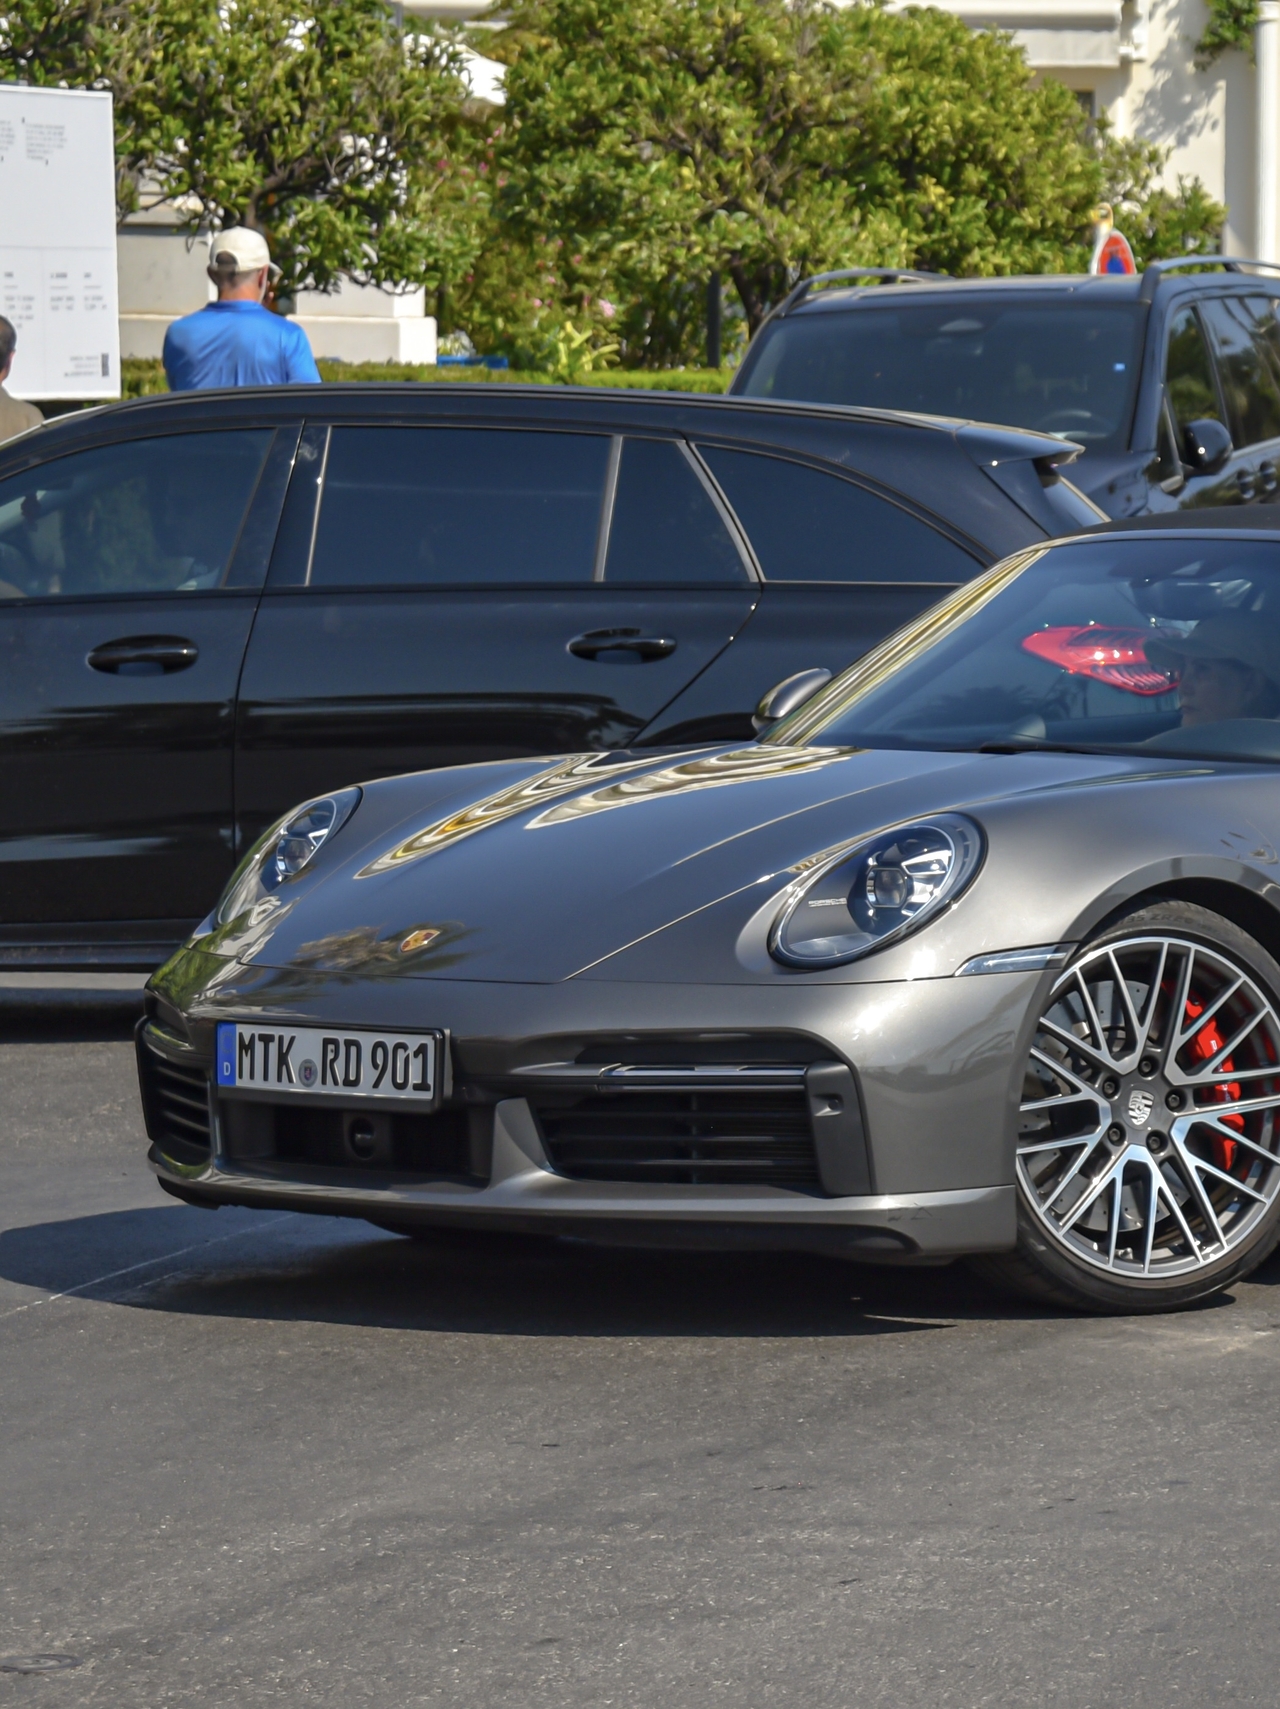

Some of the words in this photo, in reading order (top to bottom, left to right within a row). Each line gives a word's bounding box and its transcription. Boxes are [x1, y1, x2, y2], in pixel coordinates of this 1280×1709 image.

[223, 1061, 231, 1076] D
[238, 1031, 297, 1084] MTK
[321, 1037, 363, 1087] RD
[371, 1040, 432, 1092] 901
